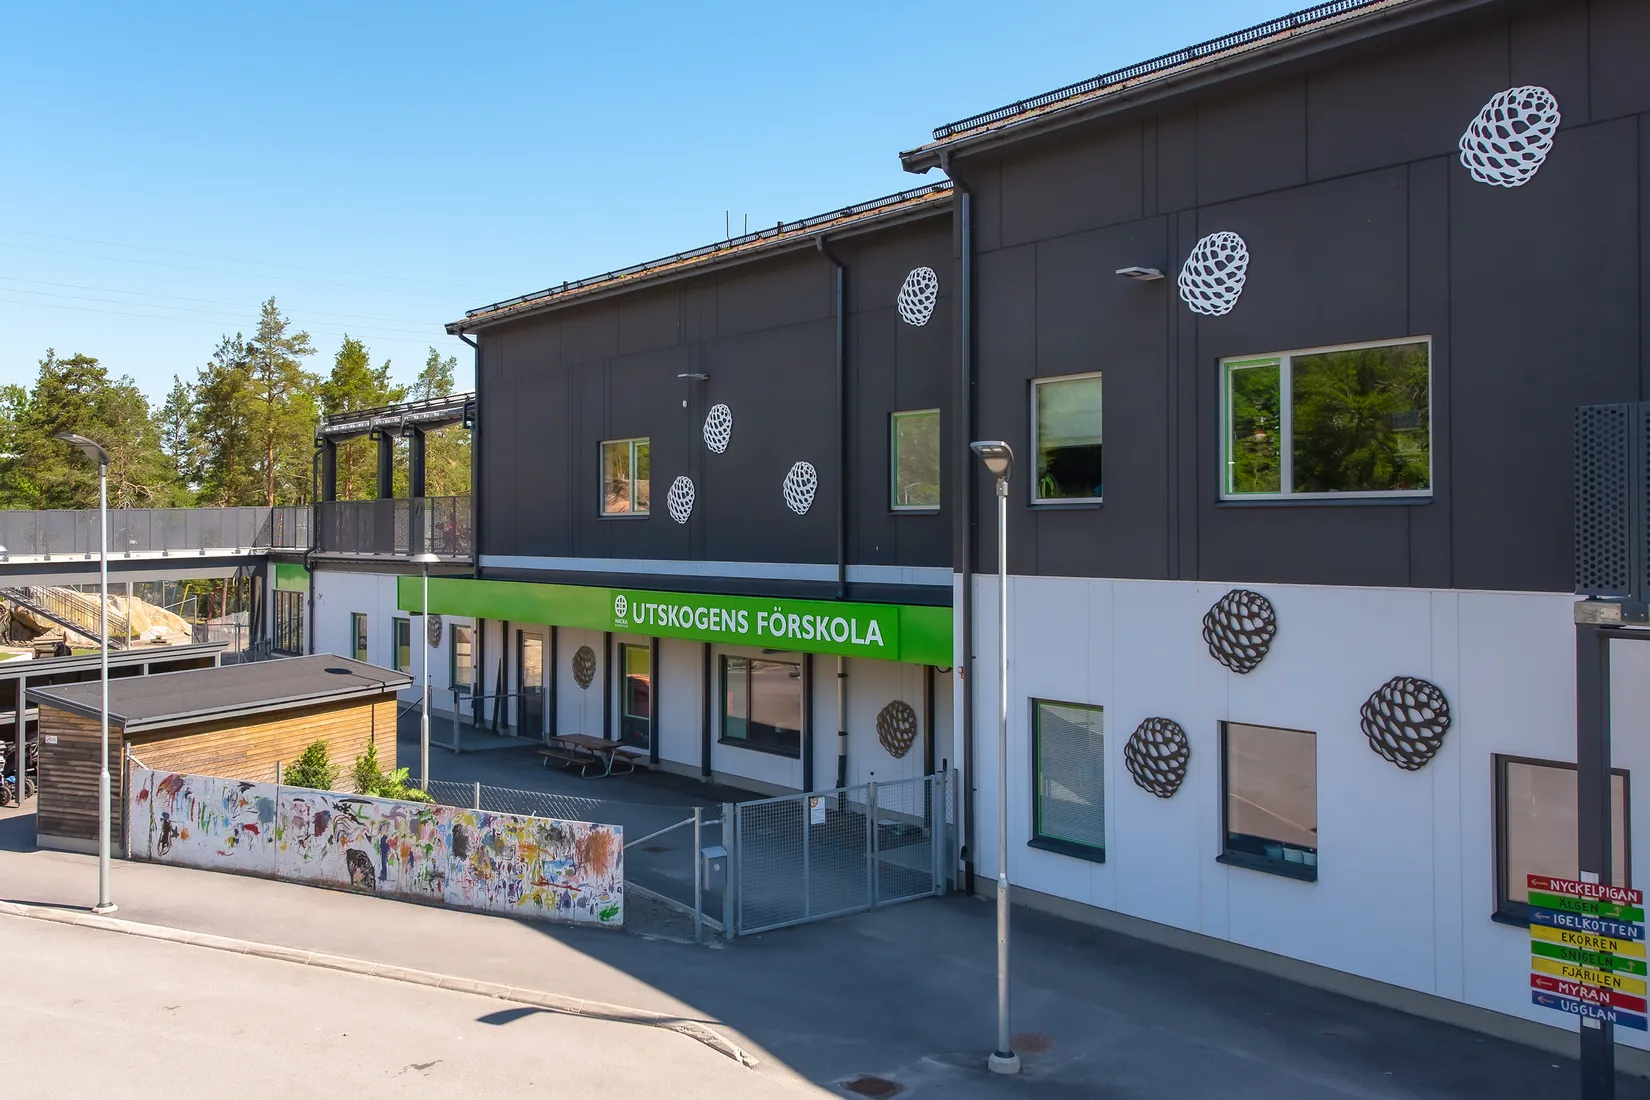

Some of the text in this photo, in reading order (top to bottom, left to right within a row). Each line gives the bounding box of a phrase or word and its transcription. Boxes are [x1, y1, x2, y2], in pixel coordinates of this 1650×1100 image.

[632, 602, 885, 646] UTSKOGENS FÖRSKOLA
[1550, 879, 1638, 902] NYCKELPIGAN
[1559, 897, 1599, 913] ÄLGEN
[1553, 914, 1638, 937] IGELKOTTEN
[1561, 932, 1618, 951] EKORREN
[1560, 949, 1613, 967] SNIGELN
[1562, 966, 1621, 987] FJÄRILEN
[1558, 982, 1610, 1003] MYRAN
[1561, 999, 1617, 1022] UGGLAN
